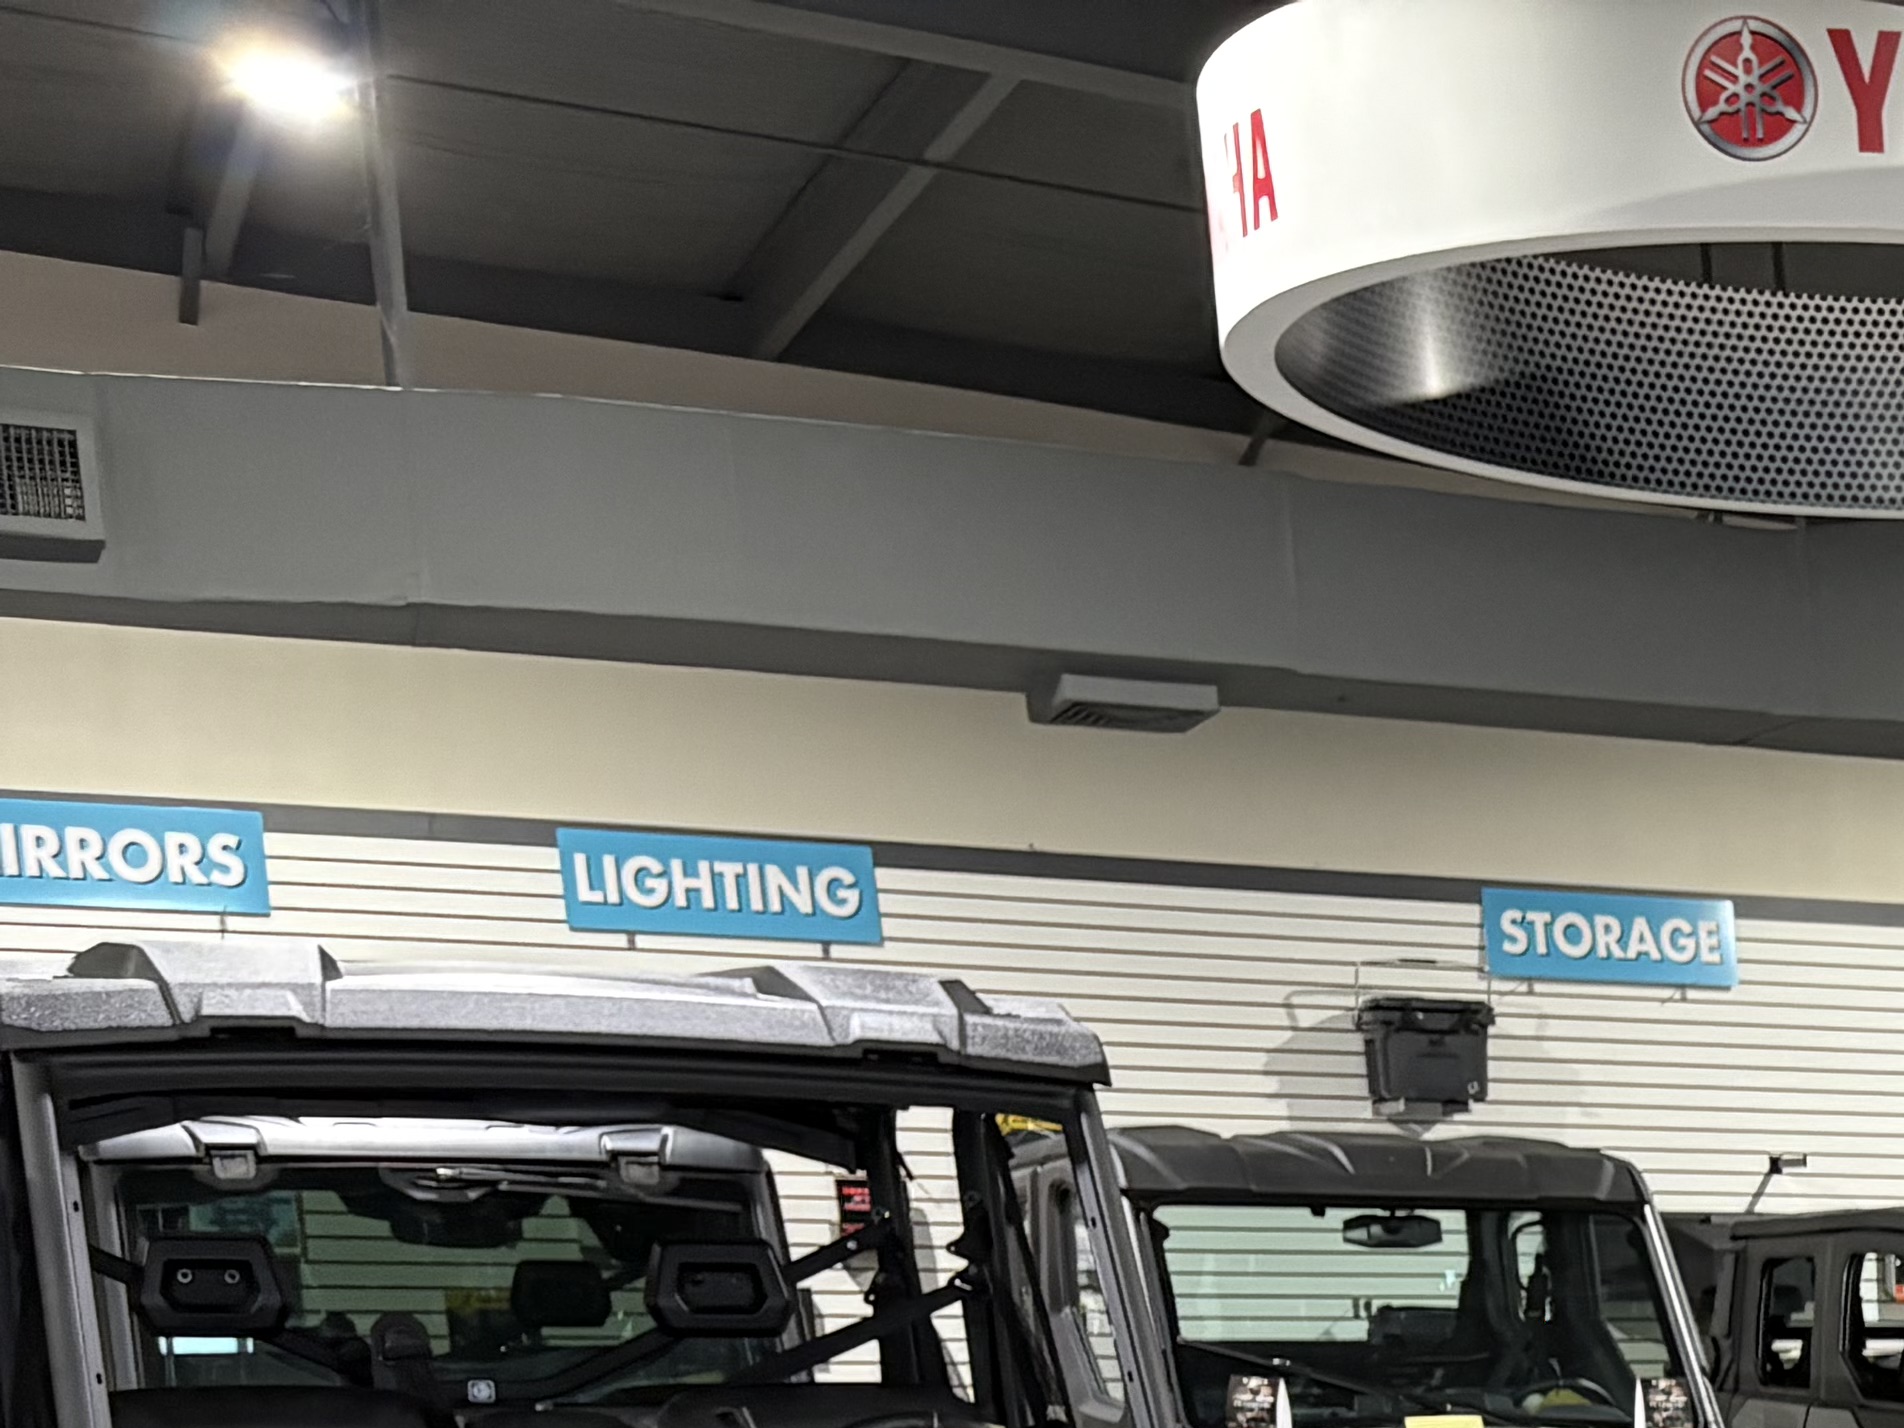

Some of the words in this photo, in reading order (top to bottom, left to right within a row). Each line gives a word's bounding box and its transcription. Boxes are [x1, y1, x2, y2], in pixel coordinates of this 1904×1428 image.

[0, 822, 249, 888] IRRORS
[573, 854, 862, 918] LIGHTING
[1500, 909, 1723, 965] STORAGE
